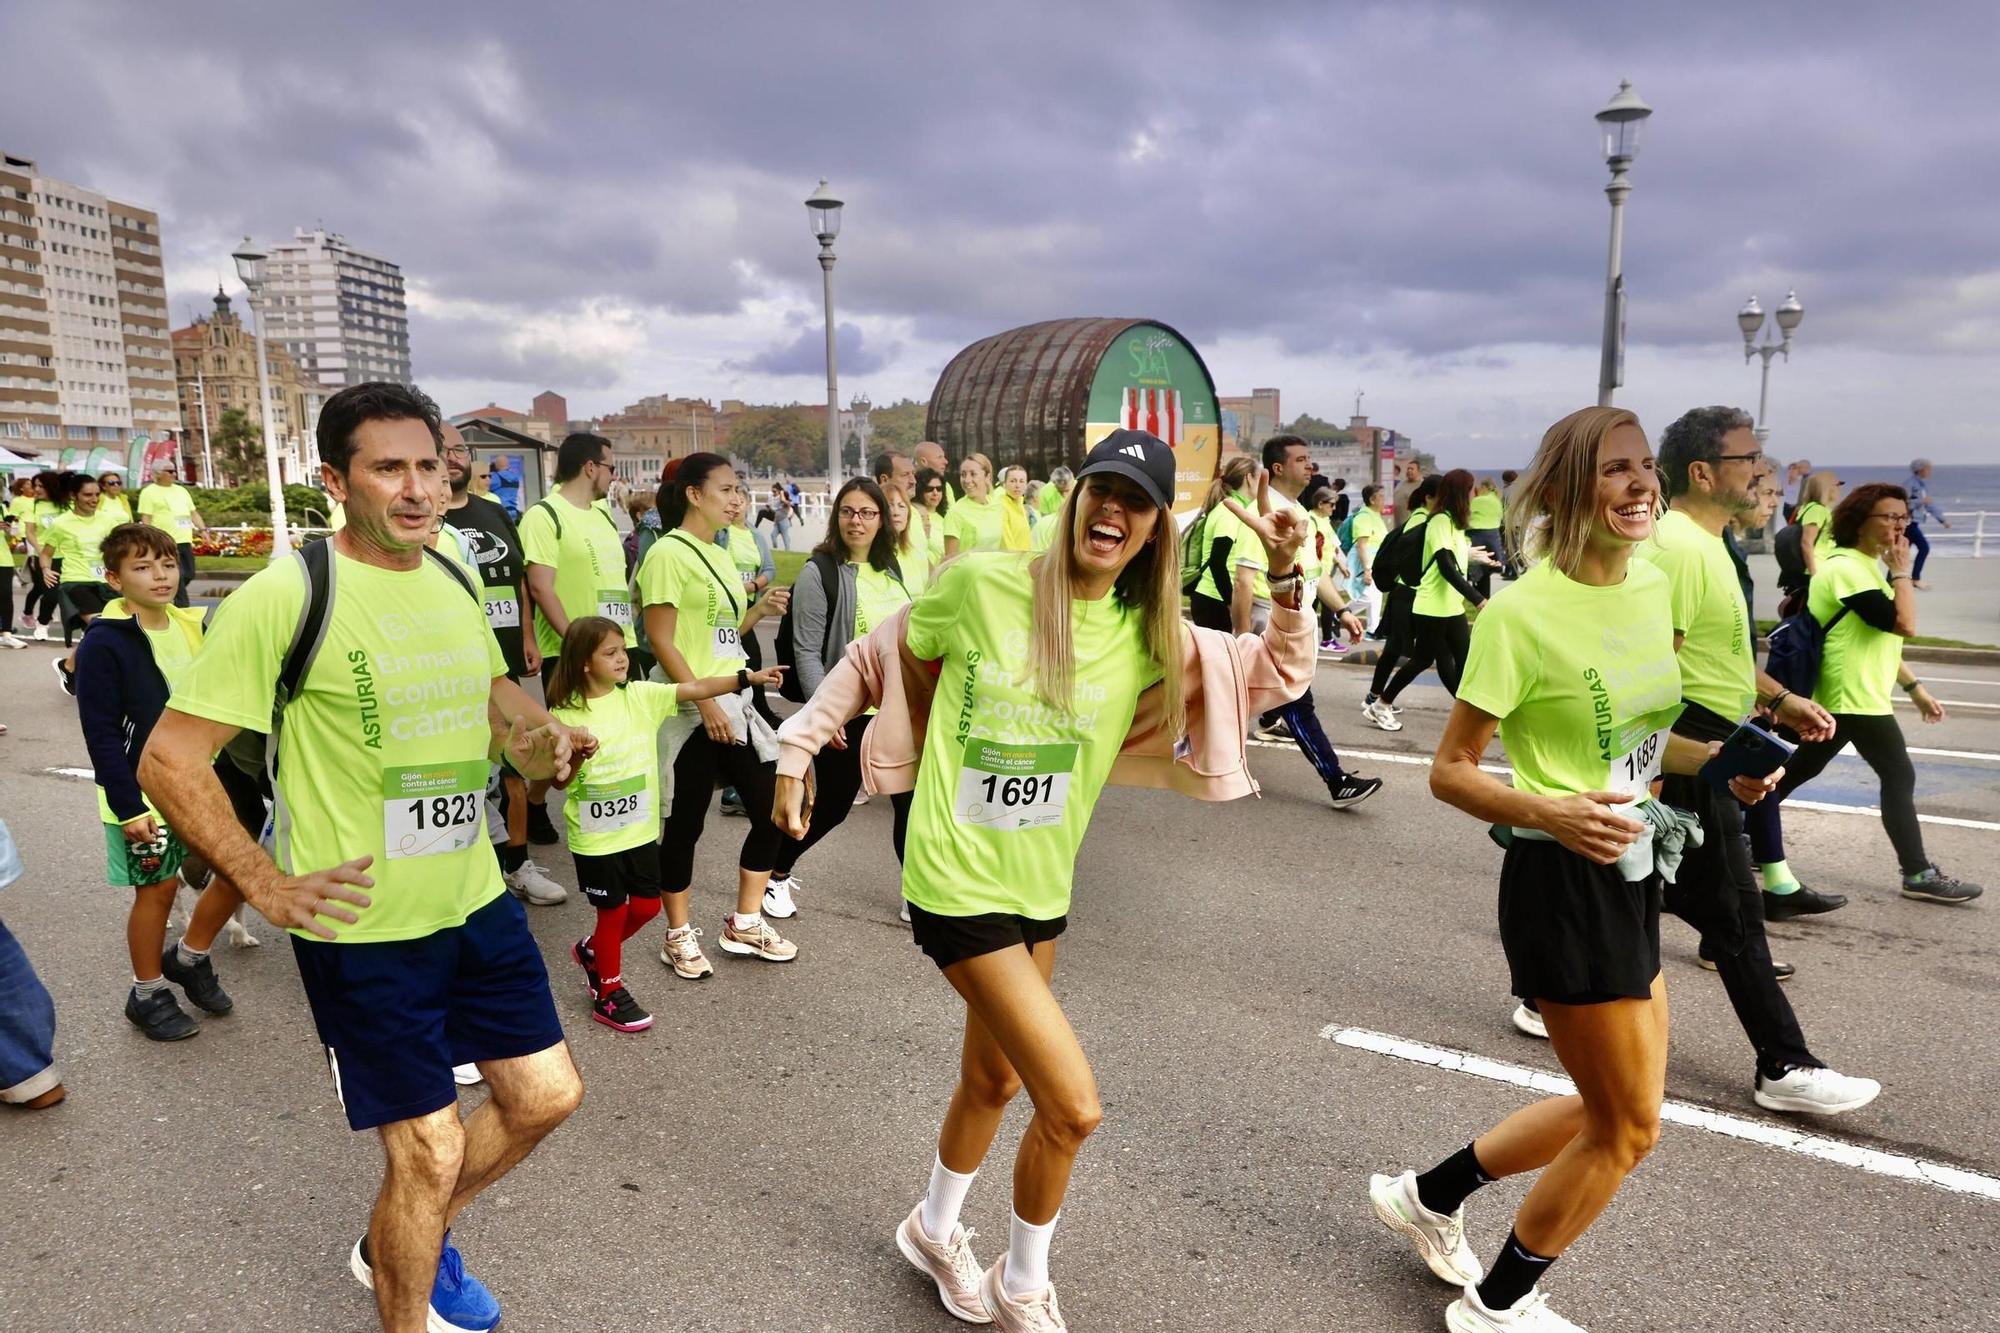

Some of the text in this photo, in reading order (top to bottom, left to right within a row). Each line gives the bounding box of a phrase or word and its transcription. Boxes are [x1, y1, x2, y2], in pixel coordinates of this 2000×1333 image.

[348, 650, 382, 750] ASTURIAS
[385, 675, 476, 706] contra
[956, 650, 981, 749] ASTURIAS
[1584, 667, 1612, 762] ASTURIAS
[1625, 732, 1657, 782] 1689
[409, 793, 475, 830] 1823
[591, 794, 637, 819] 0328
[982, 775, 1054, 806] 1691
